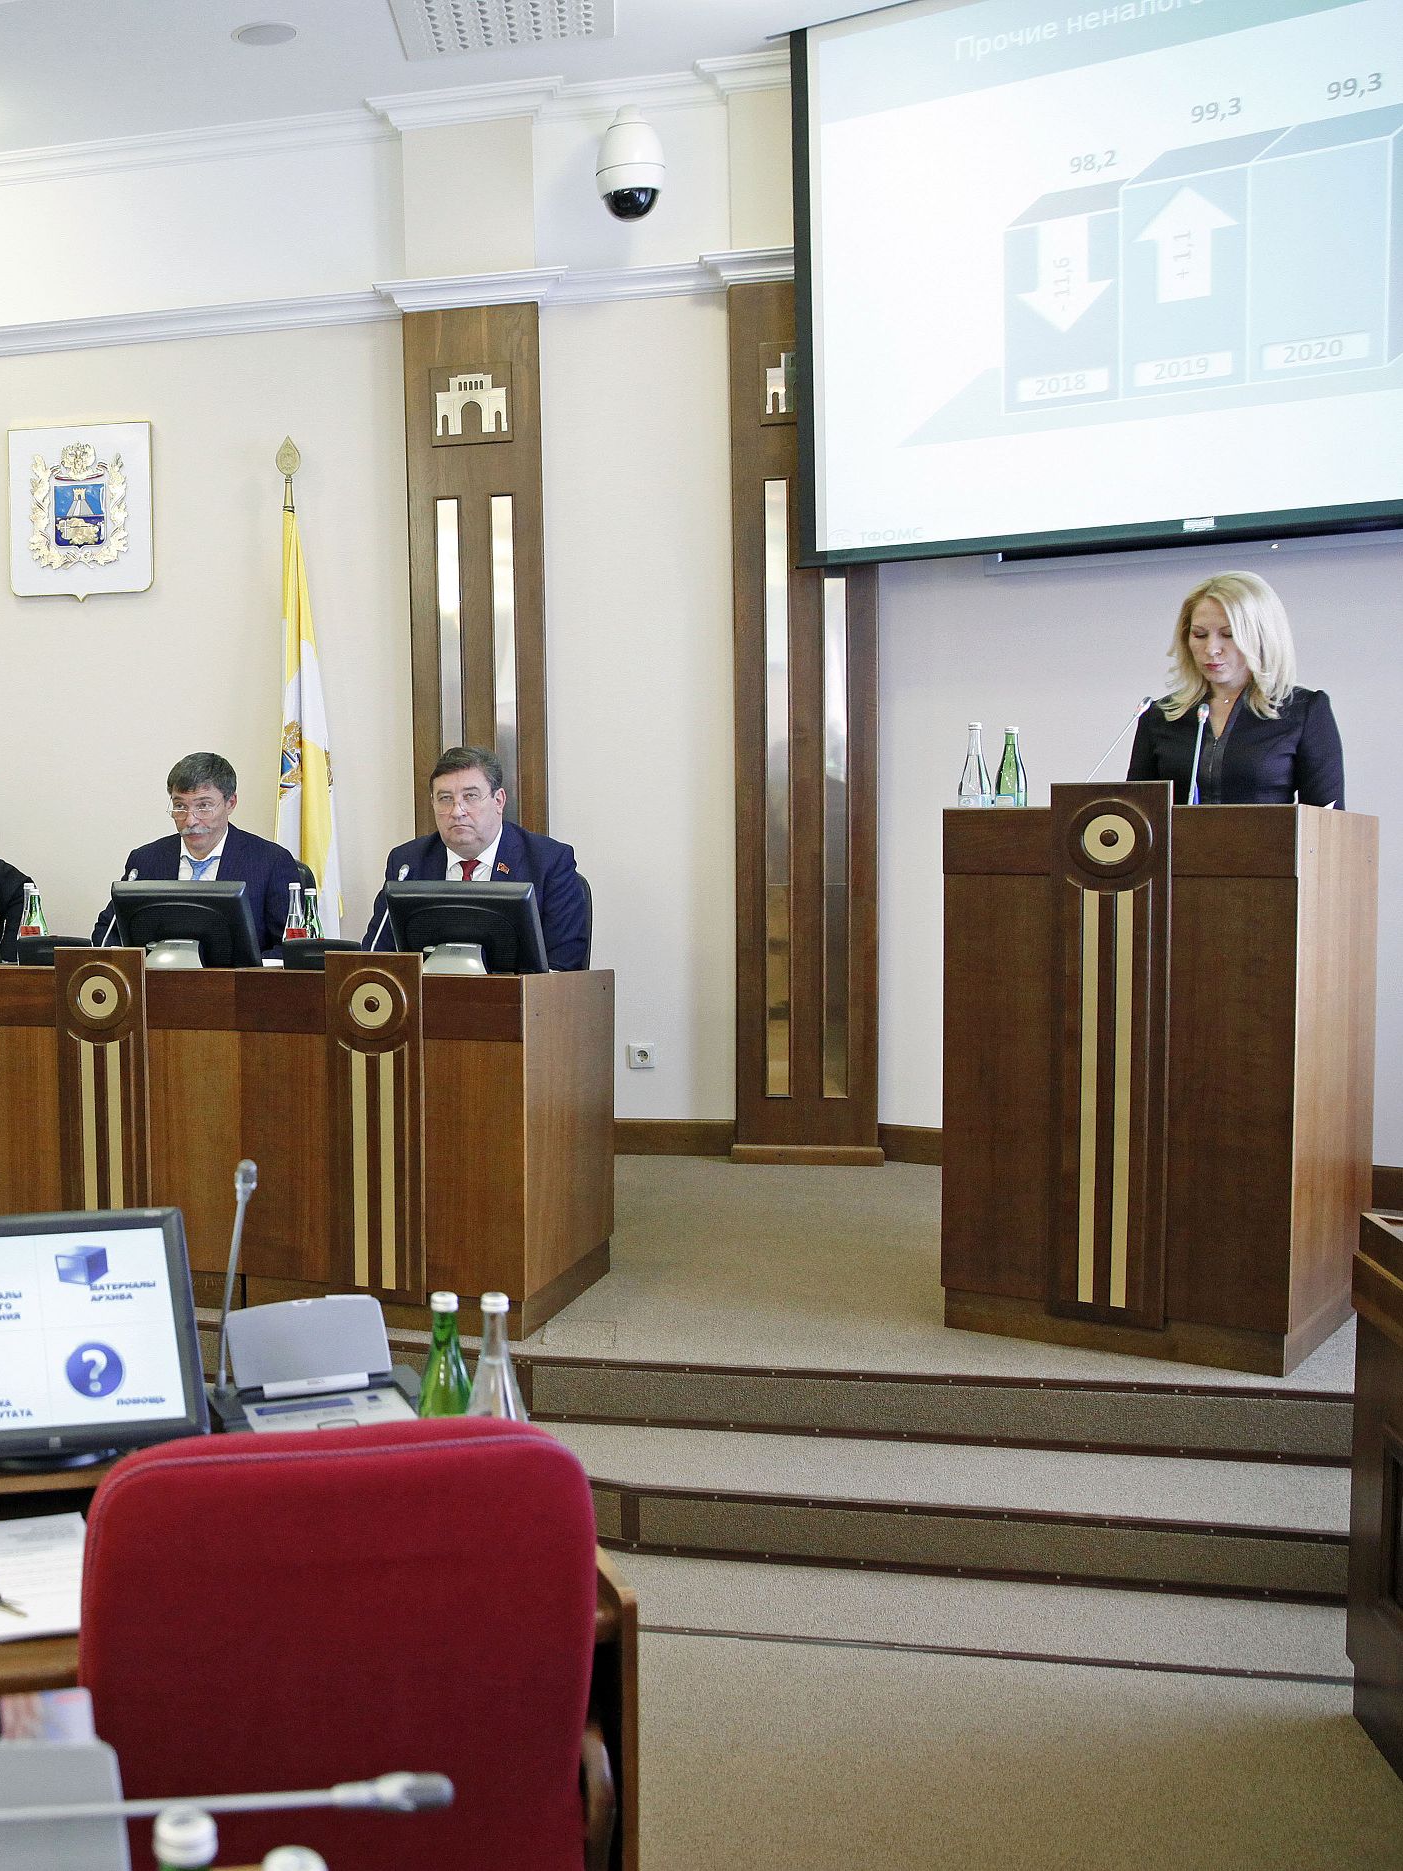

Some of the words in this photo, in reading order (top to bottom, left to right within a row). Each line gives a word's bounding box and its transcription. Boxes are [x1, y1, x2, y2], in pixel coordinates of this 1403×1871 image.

[955, 20, 1058, 62] Прочие
[1326, 71, 1382, 101] 99,3
[1190, 96, 1243, 124] 99,3
[1069, 149, 1117, 174] 98,2
[1283, 338, 1344, 364] 2020
[1153, 356, 1210, 381] 2019
[1034, 373, 1087, 396] 2018
